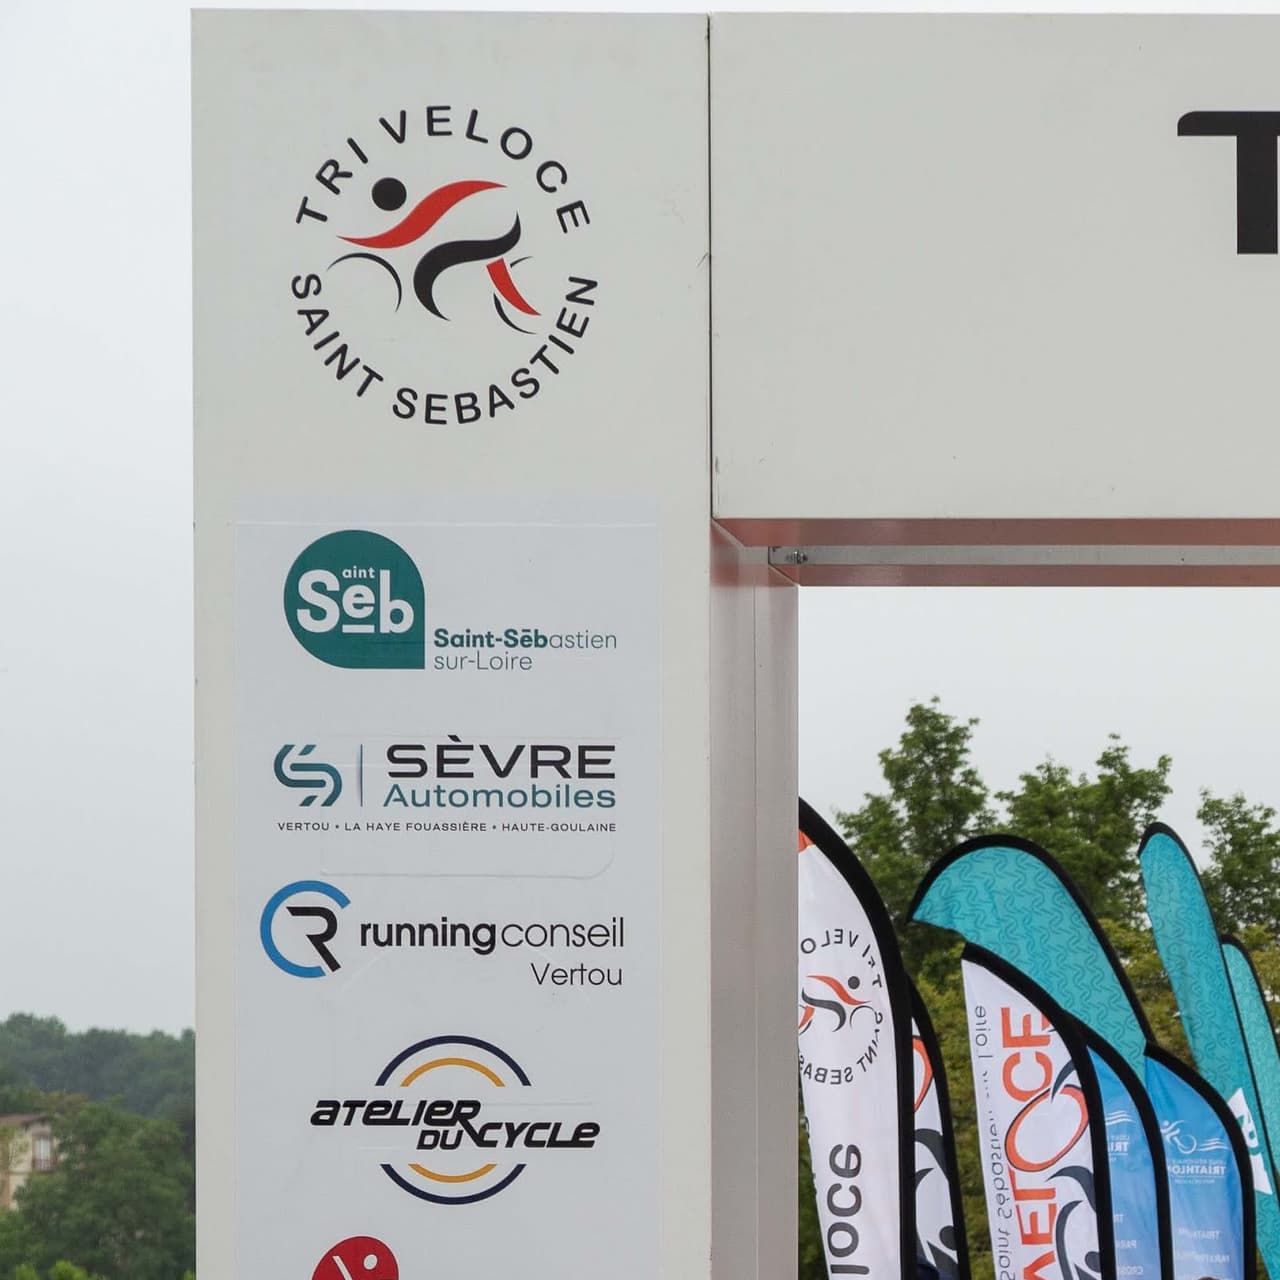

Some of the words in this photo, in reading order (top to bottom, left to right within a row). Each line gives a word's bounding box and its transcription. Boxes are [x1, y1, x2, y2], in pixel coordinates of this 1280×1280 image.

[291, 273, 383, 397] SAINT
[392, 276, 597, 424] SEBASTIEN
[434, 650, 532, 670] sur-Loire
[387, 735, 615, 779] SÈVRE
[384, 784, 615, 808] Automobiles
[278, 823, 329, 831] VERTOU
[345, 823, 360, 831] LA
[367, 823, 400, 831] HAYE
[502, 823, 616, 831] HAUTE-GOULAINE
[531, 963, 621, 985] Vertou
[416, 1130, 464, 1150] DU
